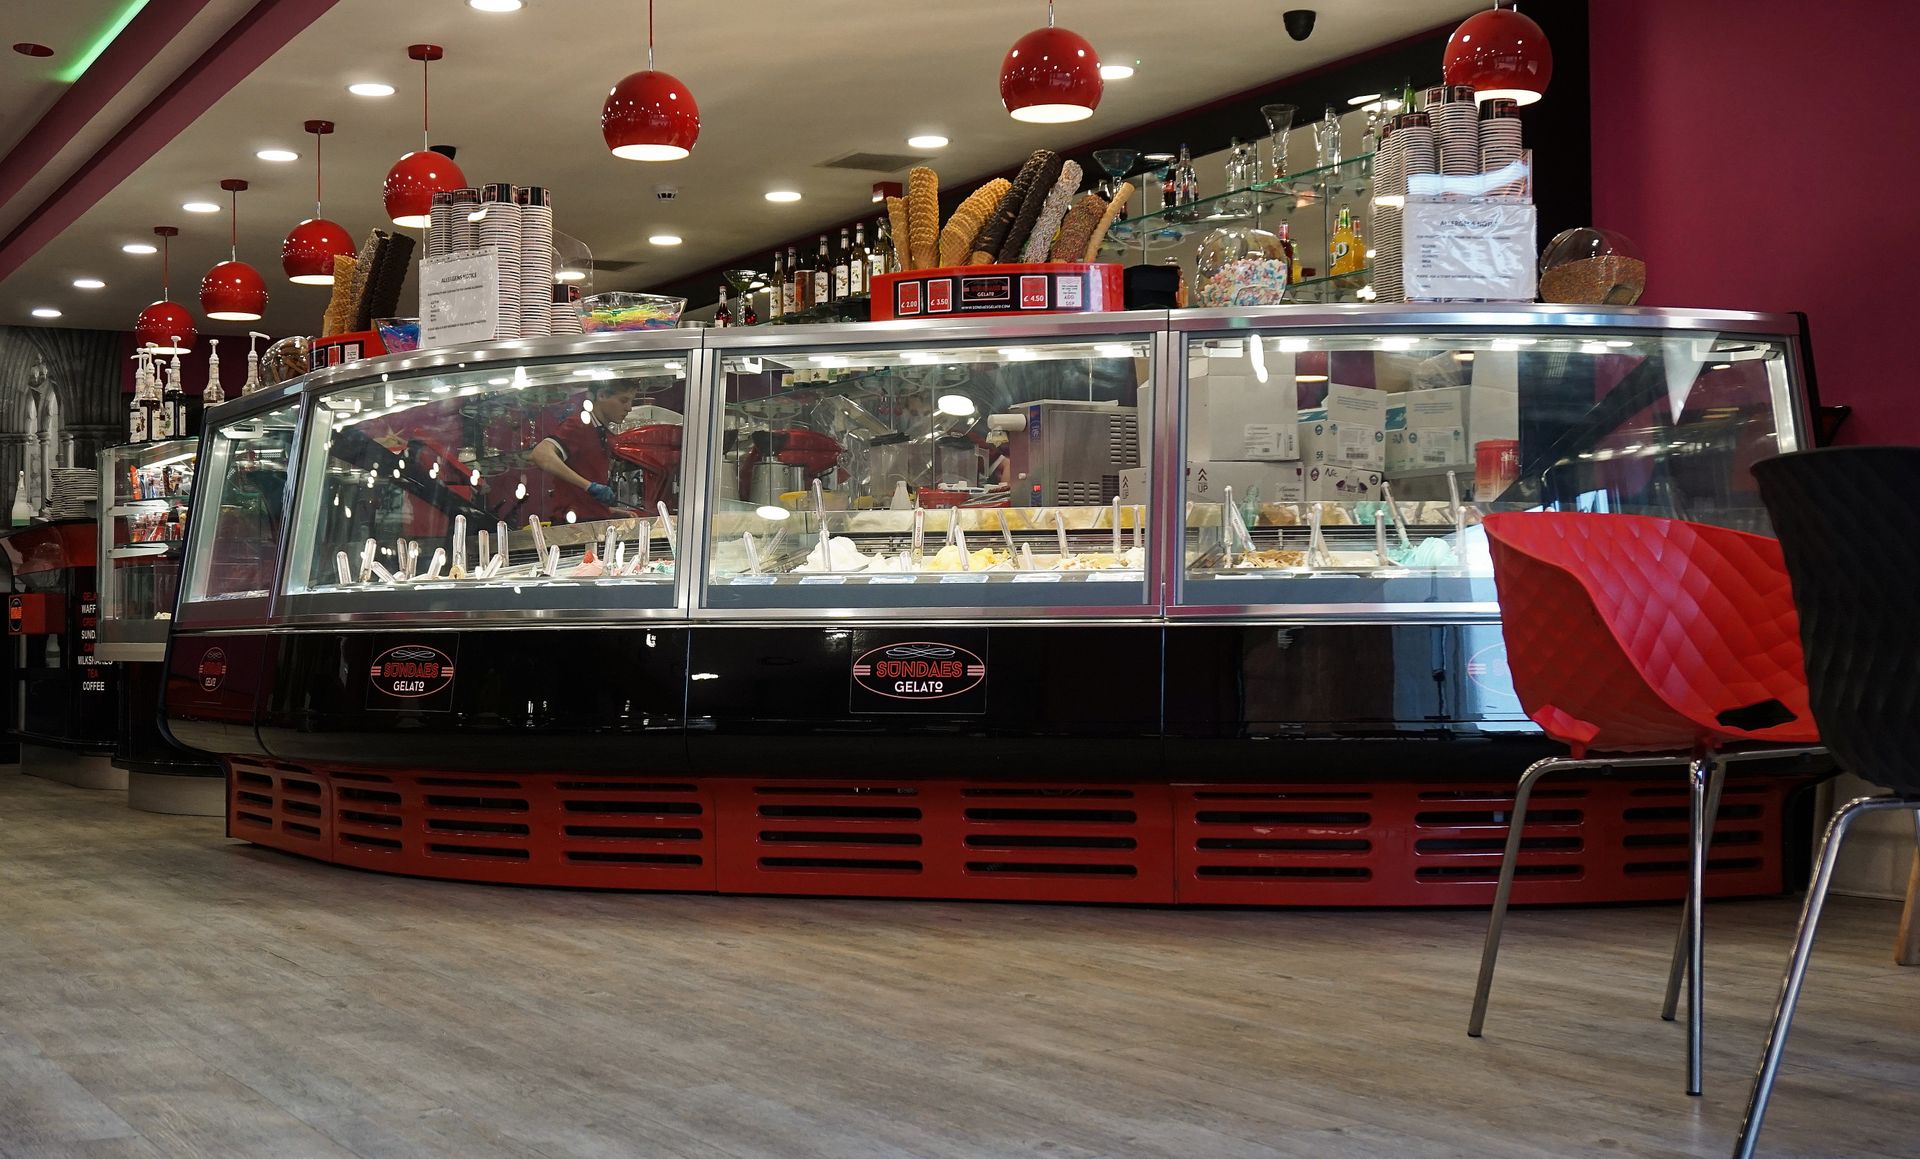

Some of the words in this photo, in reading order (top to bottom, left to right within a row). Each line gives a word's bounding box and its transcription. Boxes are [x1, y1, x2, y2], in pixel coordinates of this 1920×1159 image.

[1198, 484, 1208, 493] UP
[384, 662, 439, 678] SUNDAES
[876, 661, 963, 678] SUNDAES
[83, 681, 105, 691] COFFEE
[393, 681, 425, 691] GELATO
[894, 681, 944, 692] GELATO
